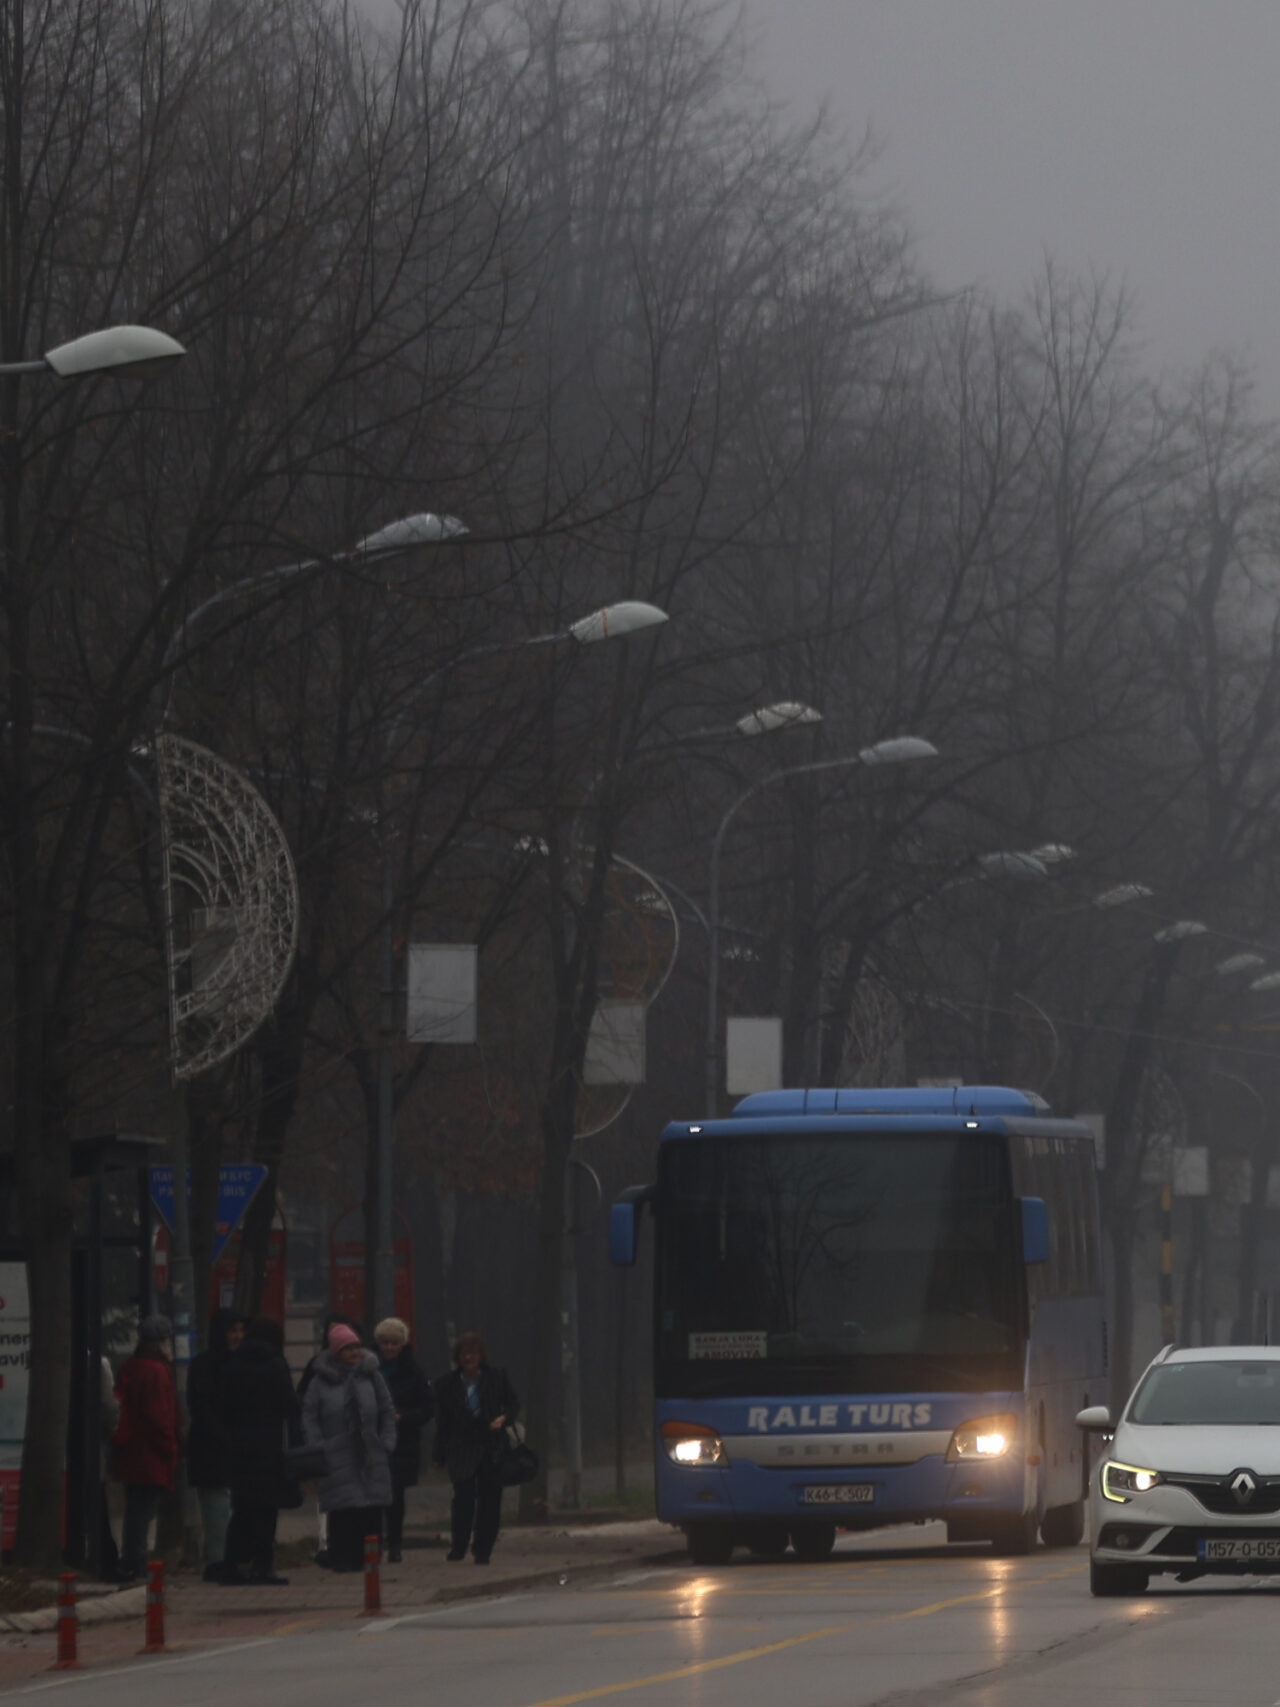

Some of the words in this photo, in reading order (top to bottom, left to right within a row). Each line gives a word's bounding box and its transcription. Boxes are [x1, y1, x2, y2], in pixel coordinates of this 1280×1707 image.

[748, 1404, 839, 1432] RALE
[848, 1402, 932, 1430] TURS
[777, 1442, 894, 1457] SETRA
